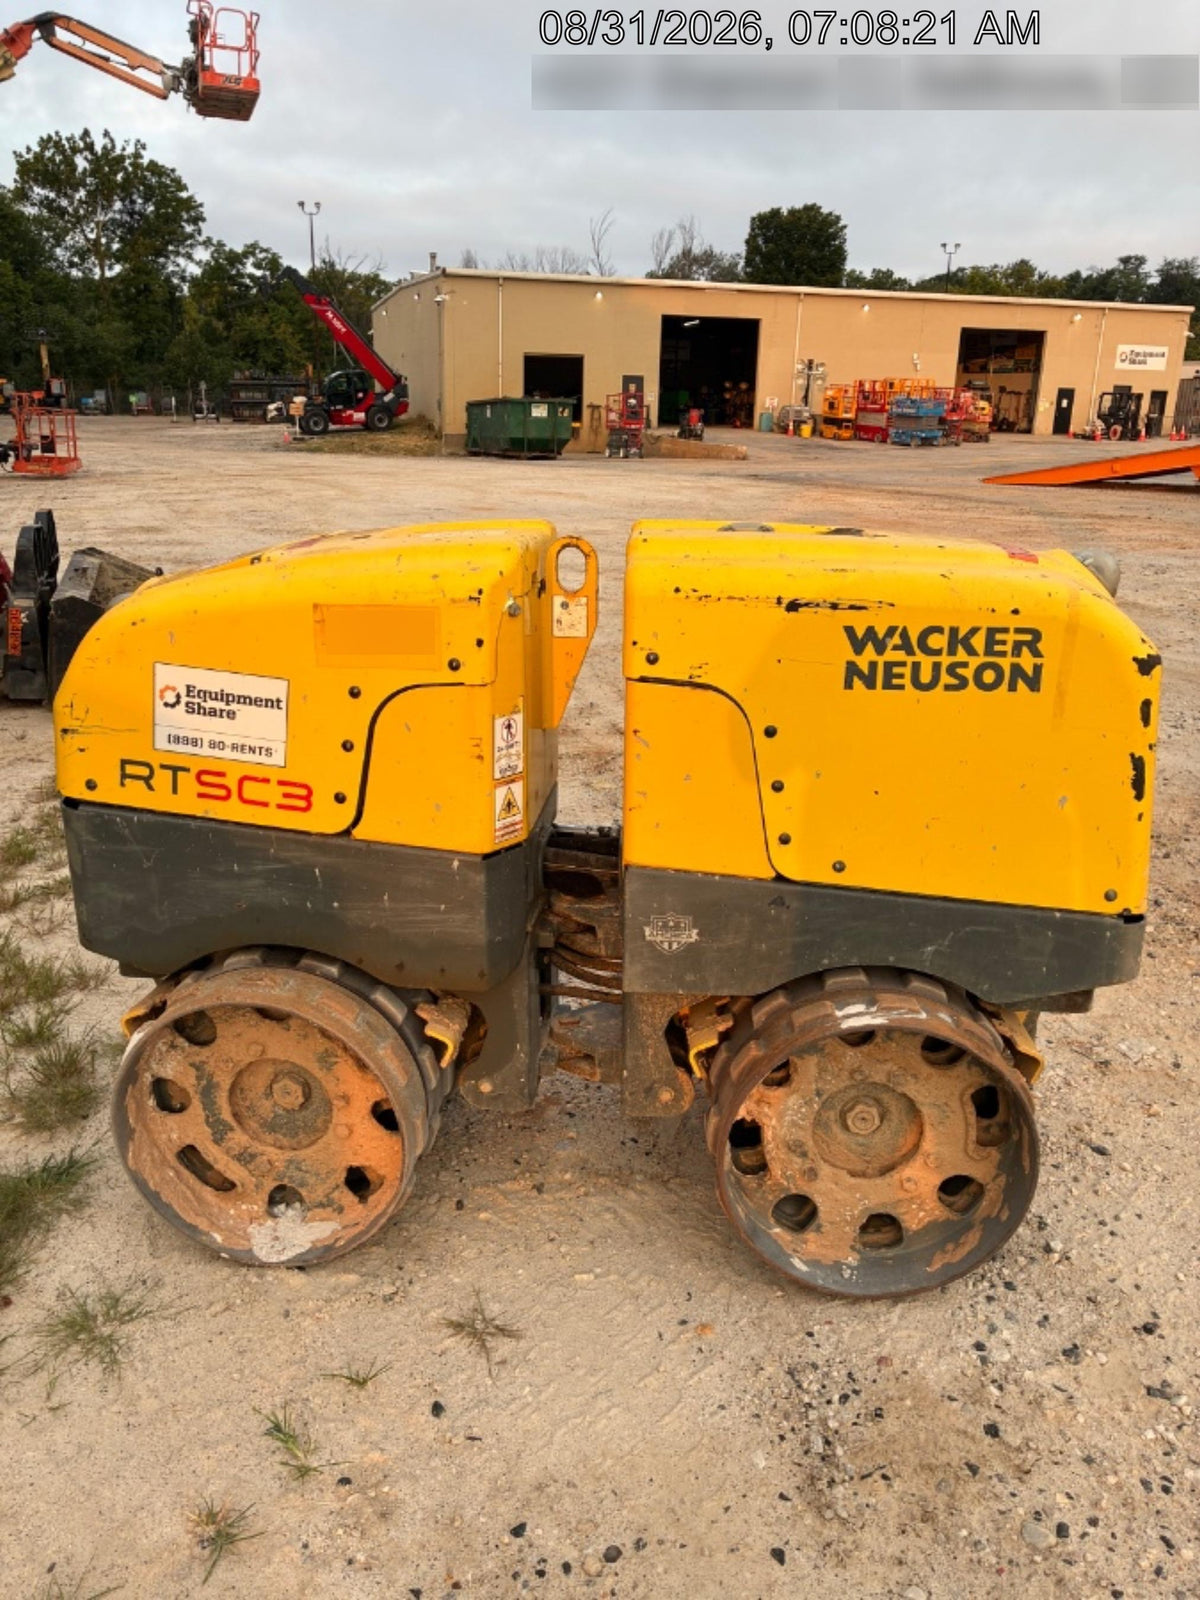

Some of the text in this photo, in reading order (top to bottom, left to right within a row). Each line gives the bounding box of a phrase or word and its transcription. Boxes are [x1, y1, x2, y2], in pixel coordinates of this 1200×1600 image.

[843, 625, 1044, 658] WACKER
[844, 660, 1043, 693] NEUSON
[185, 684, 283, 710] Equipment
[185, 701, 237, 721] Share
[167, 733, 203, 749] (888)
